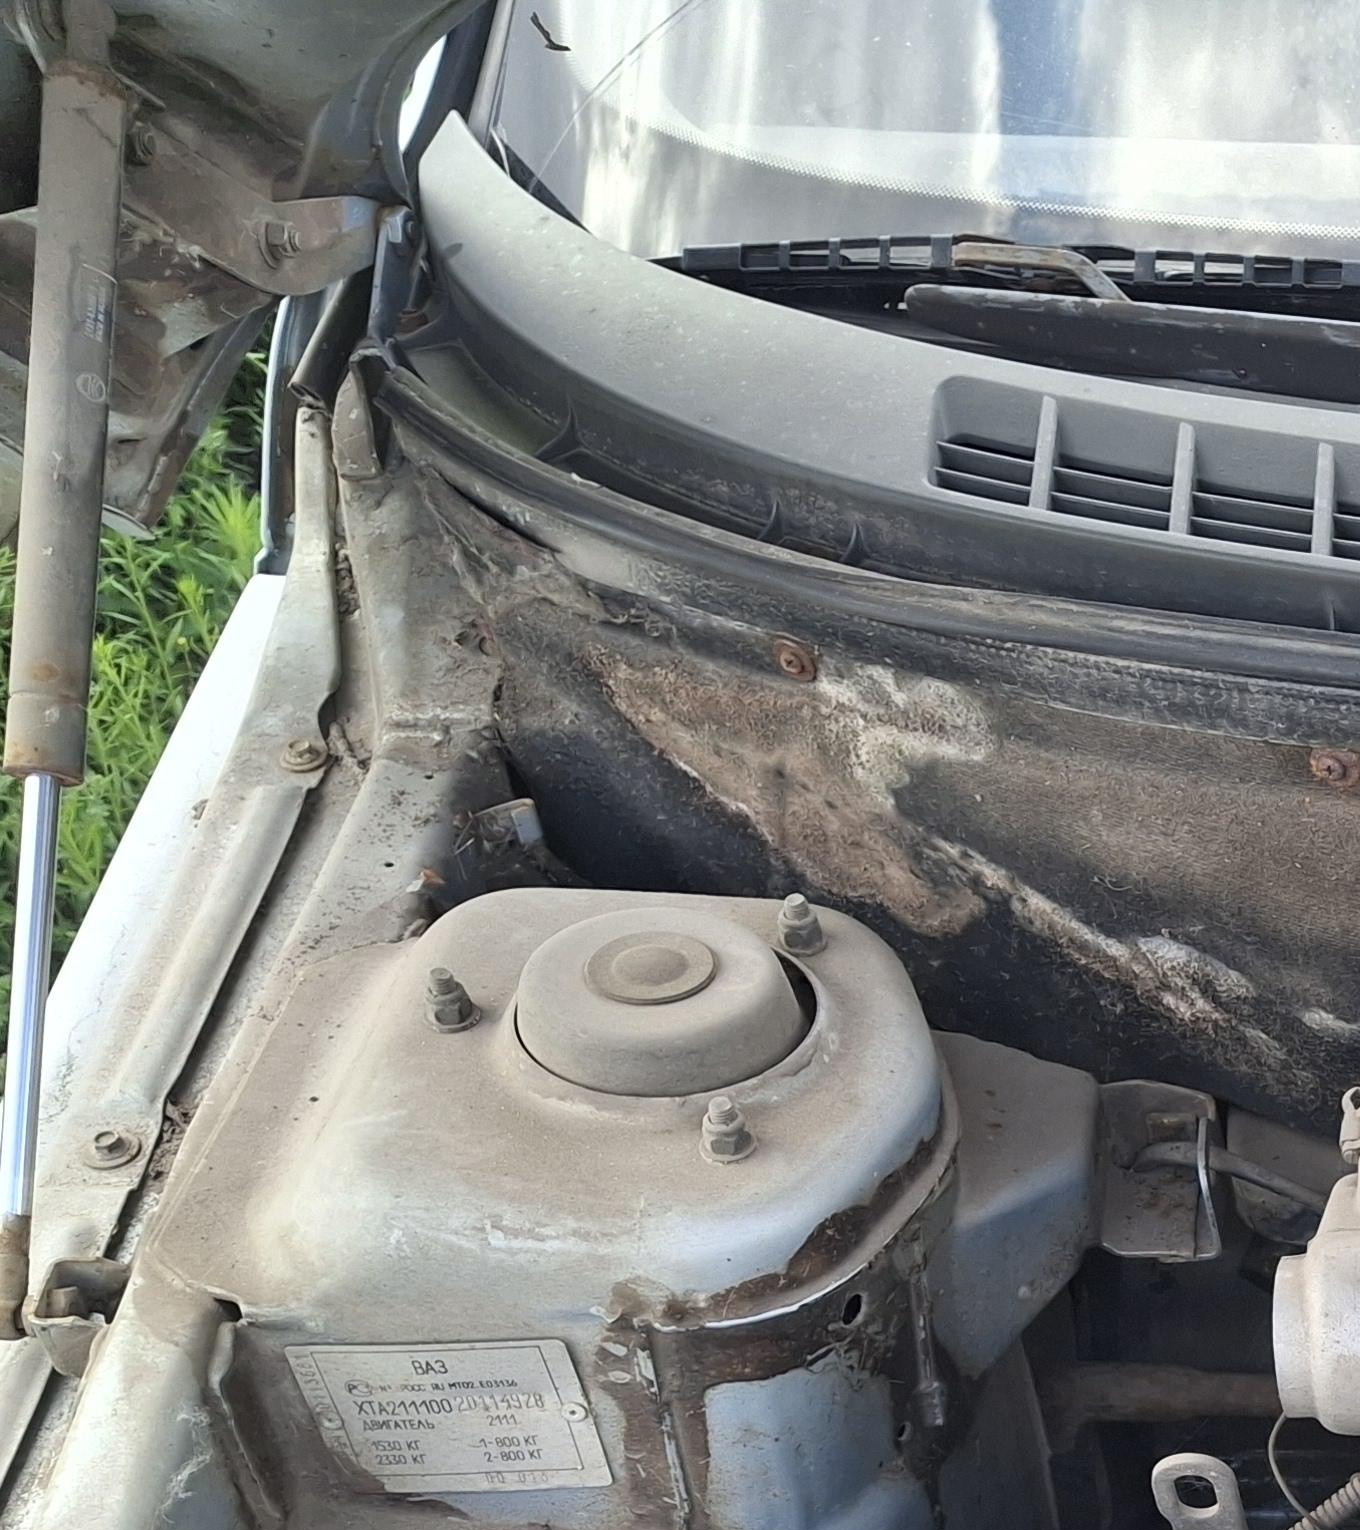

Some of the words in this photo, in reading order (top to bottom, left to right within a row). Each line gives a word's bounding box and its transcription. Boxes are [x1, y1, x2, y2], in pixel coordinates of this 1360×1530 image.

[411, 1359, 449, 1375] ВАЗ
[362, 1419, 435, 1432] ДВИГАТЕЛЬ
[486, 1414, 518, 1427] 2111
[370, 1439, 401, 1451] 1530
[406, 1440, 421, 1451] КГ
[479, 1437, 520, 1449] 1-800
[523, 1434, 539, 1446] КГ
[375, 1454, 407, 1466] 2330
[412, 1454, 427, 1465] КГ
[485, 1450, 526, 1463] 2-800
[529, 1448, 544, 1460] КГ
